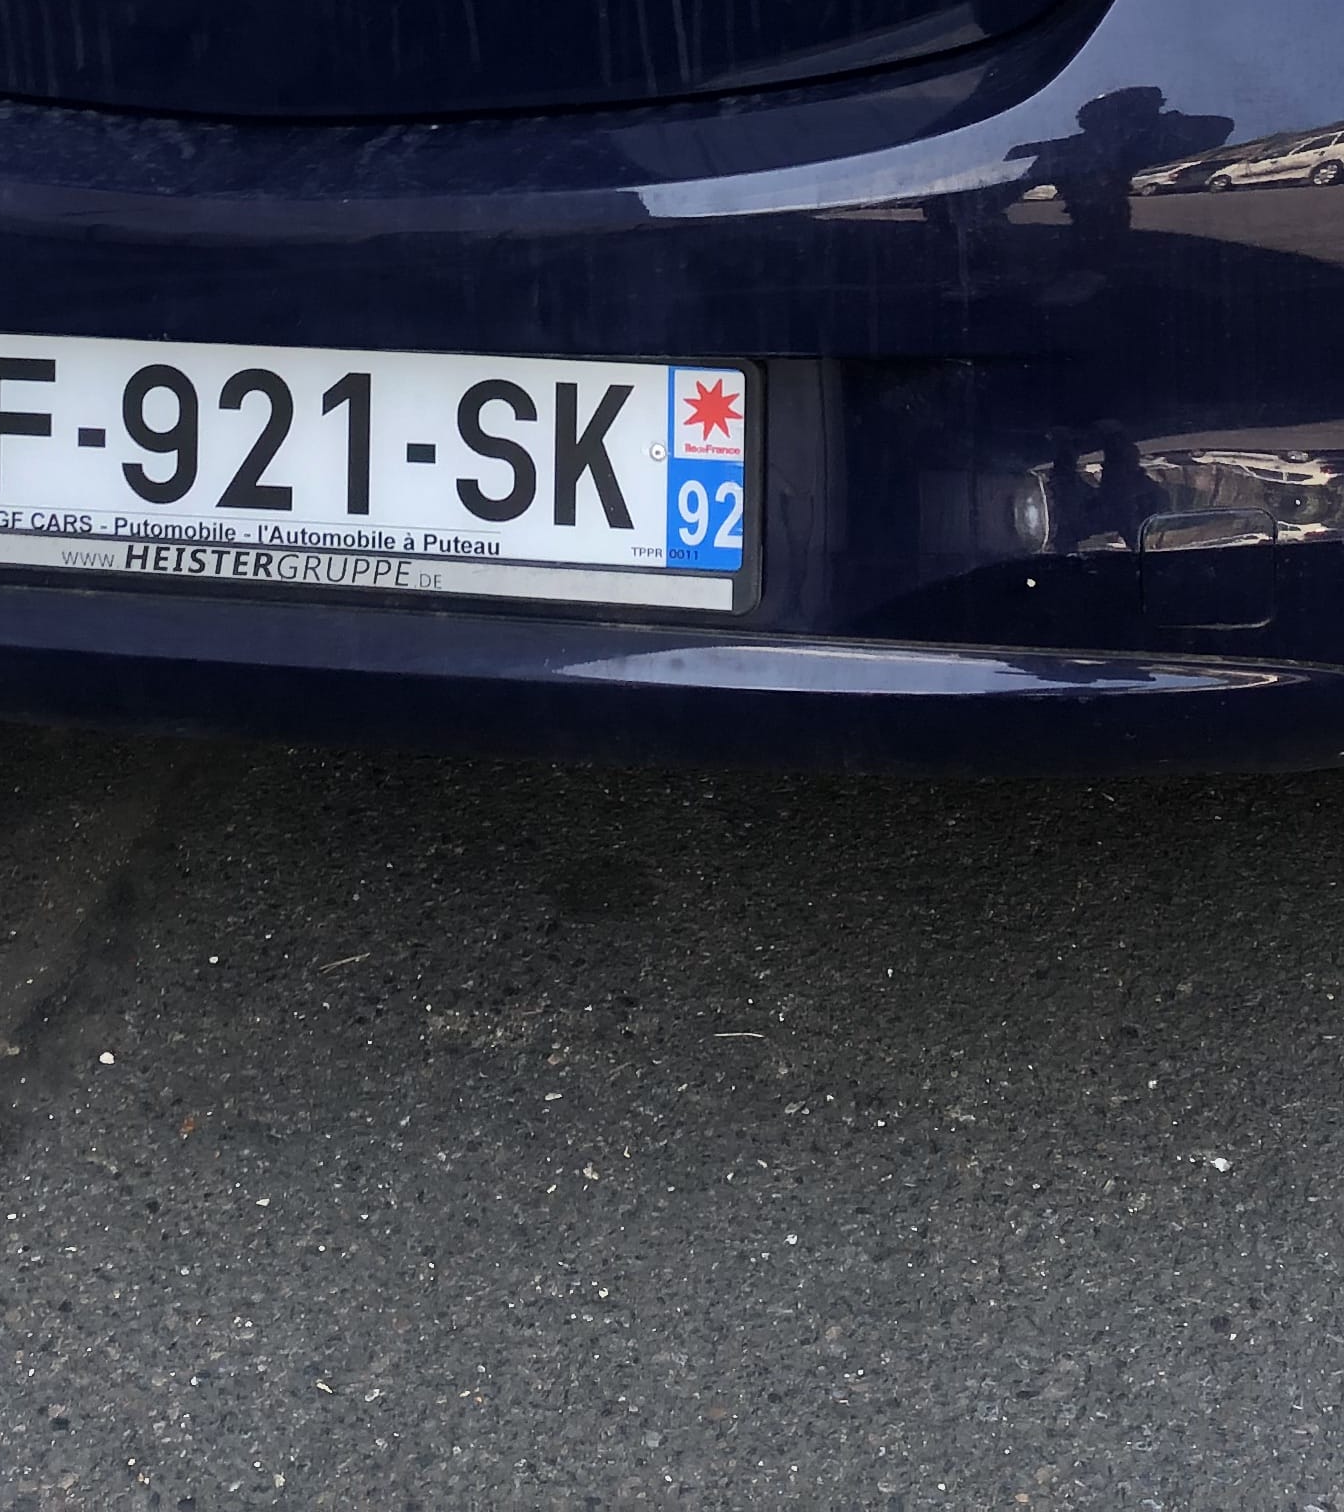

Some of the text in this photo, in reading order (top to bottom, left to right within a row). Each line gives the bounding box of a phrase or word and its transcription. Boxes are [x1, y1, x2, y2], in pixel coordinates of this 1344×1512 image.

[30, 512, 93, 533] CARS
[114, 516, 236, 541] Putomobile
[257, 524, 396, 550] l'Automobile
[402, 532, 416, 552] à
[423, 533, 501, 556] Puteau
[677, 479, 743, 549] 92
[631, 546, 663, 558] TPPR
